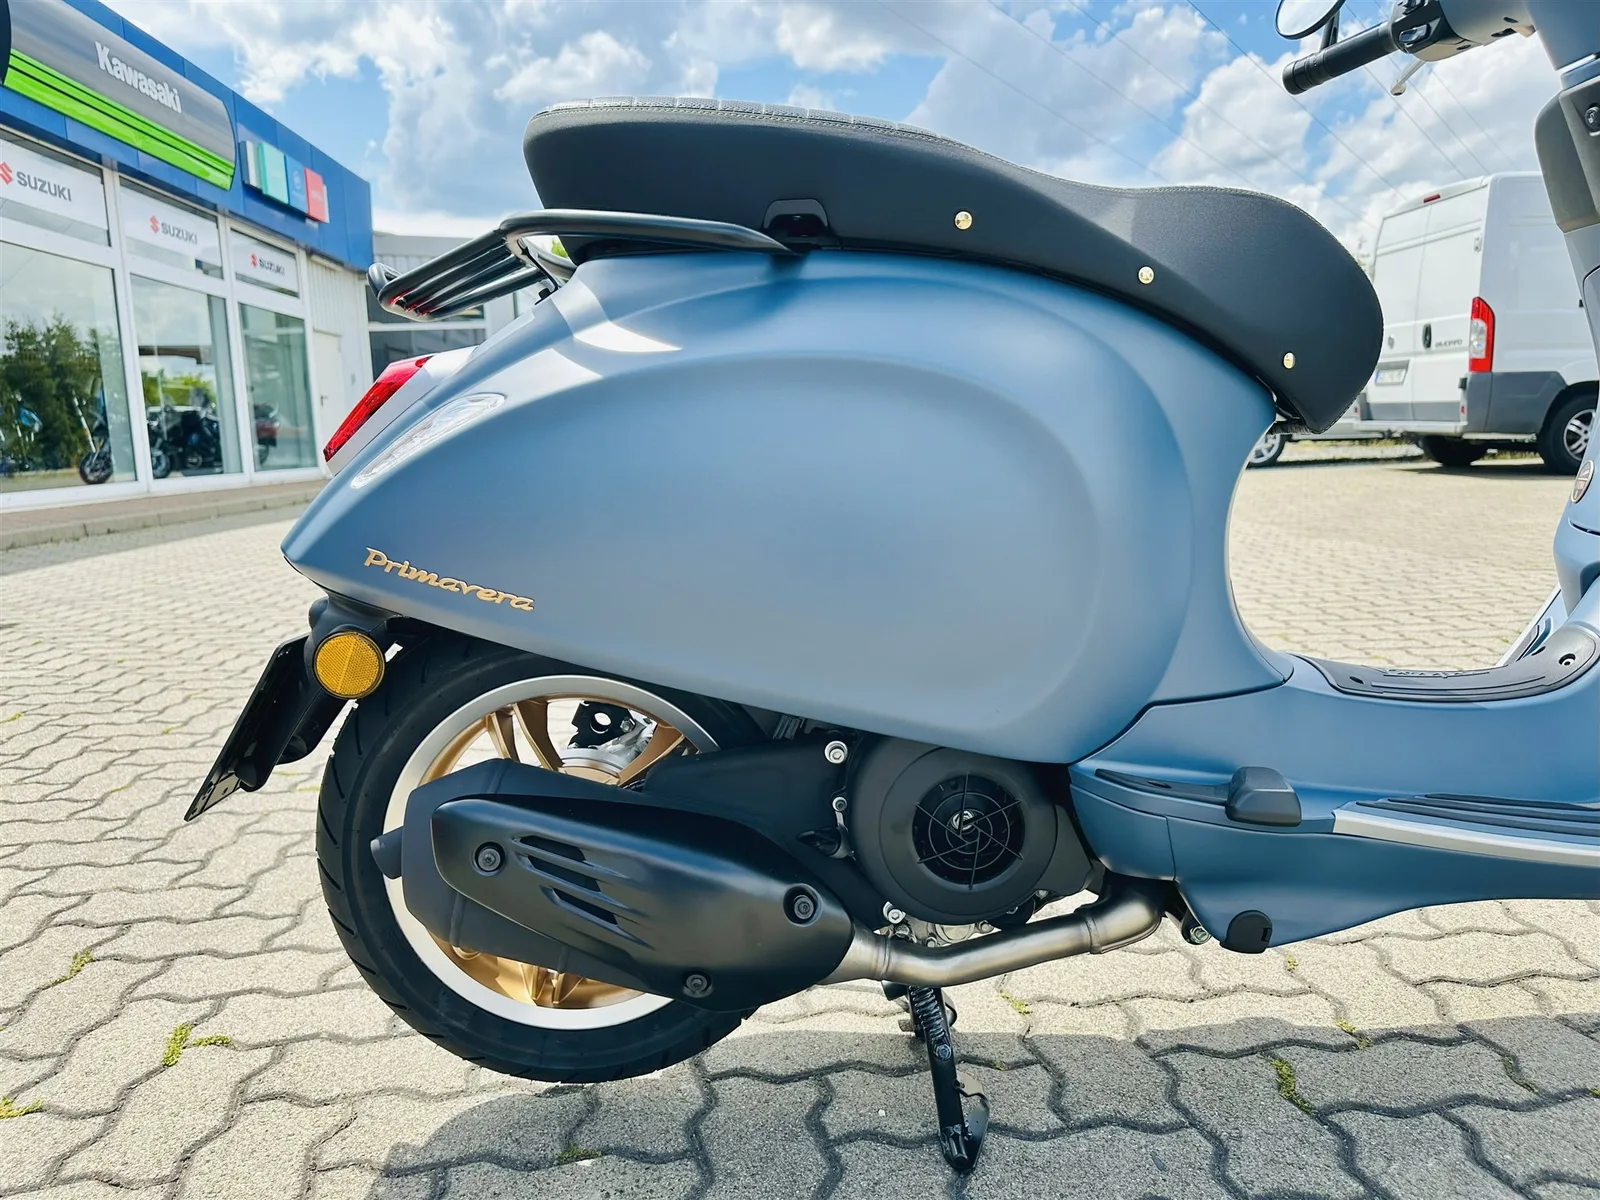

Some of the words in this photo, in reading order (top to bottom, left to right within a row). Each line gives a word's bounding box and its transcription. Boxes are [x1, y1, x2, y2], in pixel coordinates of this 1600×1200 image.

[94, 41, 182, 114] Kawasaki
[16, 171, 71, 202] SUZUKI
[161, 222, 198, 244] SUZUKI
[258, 258, 286, 275] SUZUKI
[364, 546, 535, 611] Primavera
